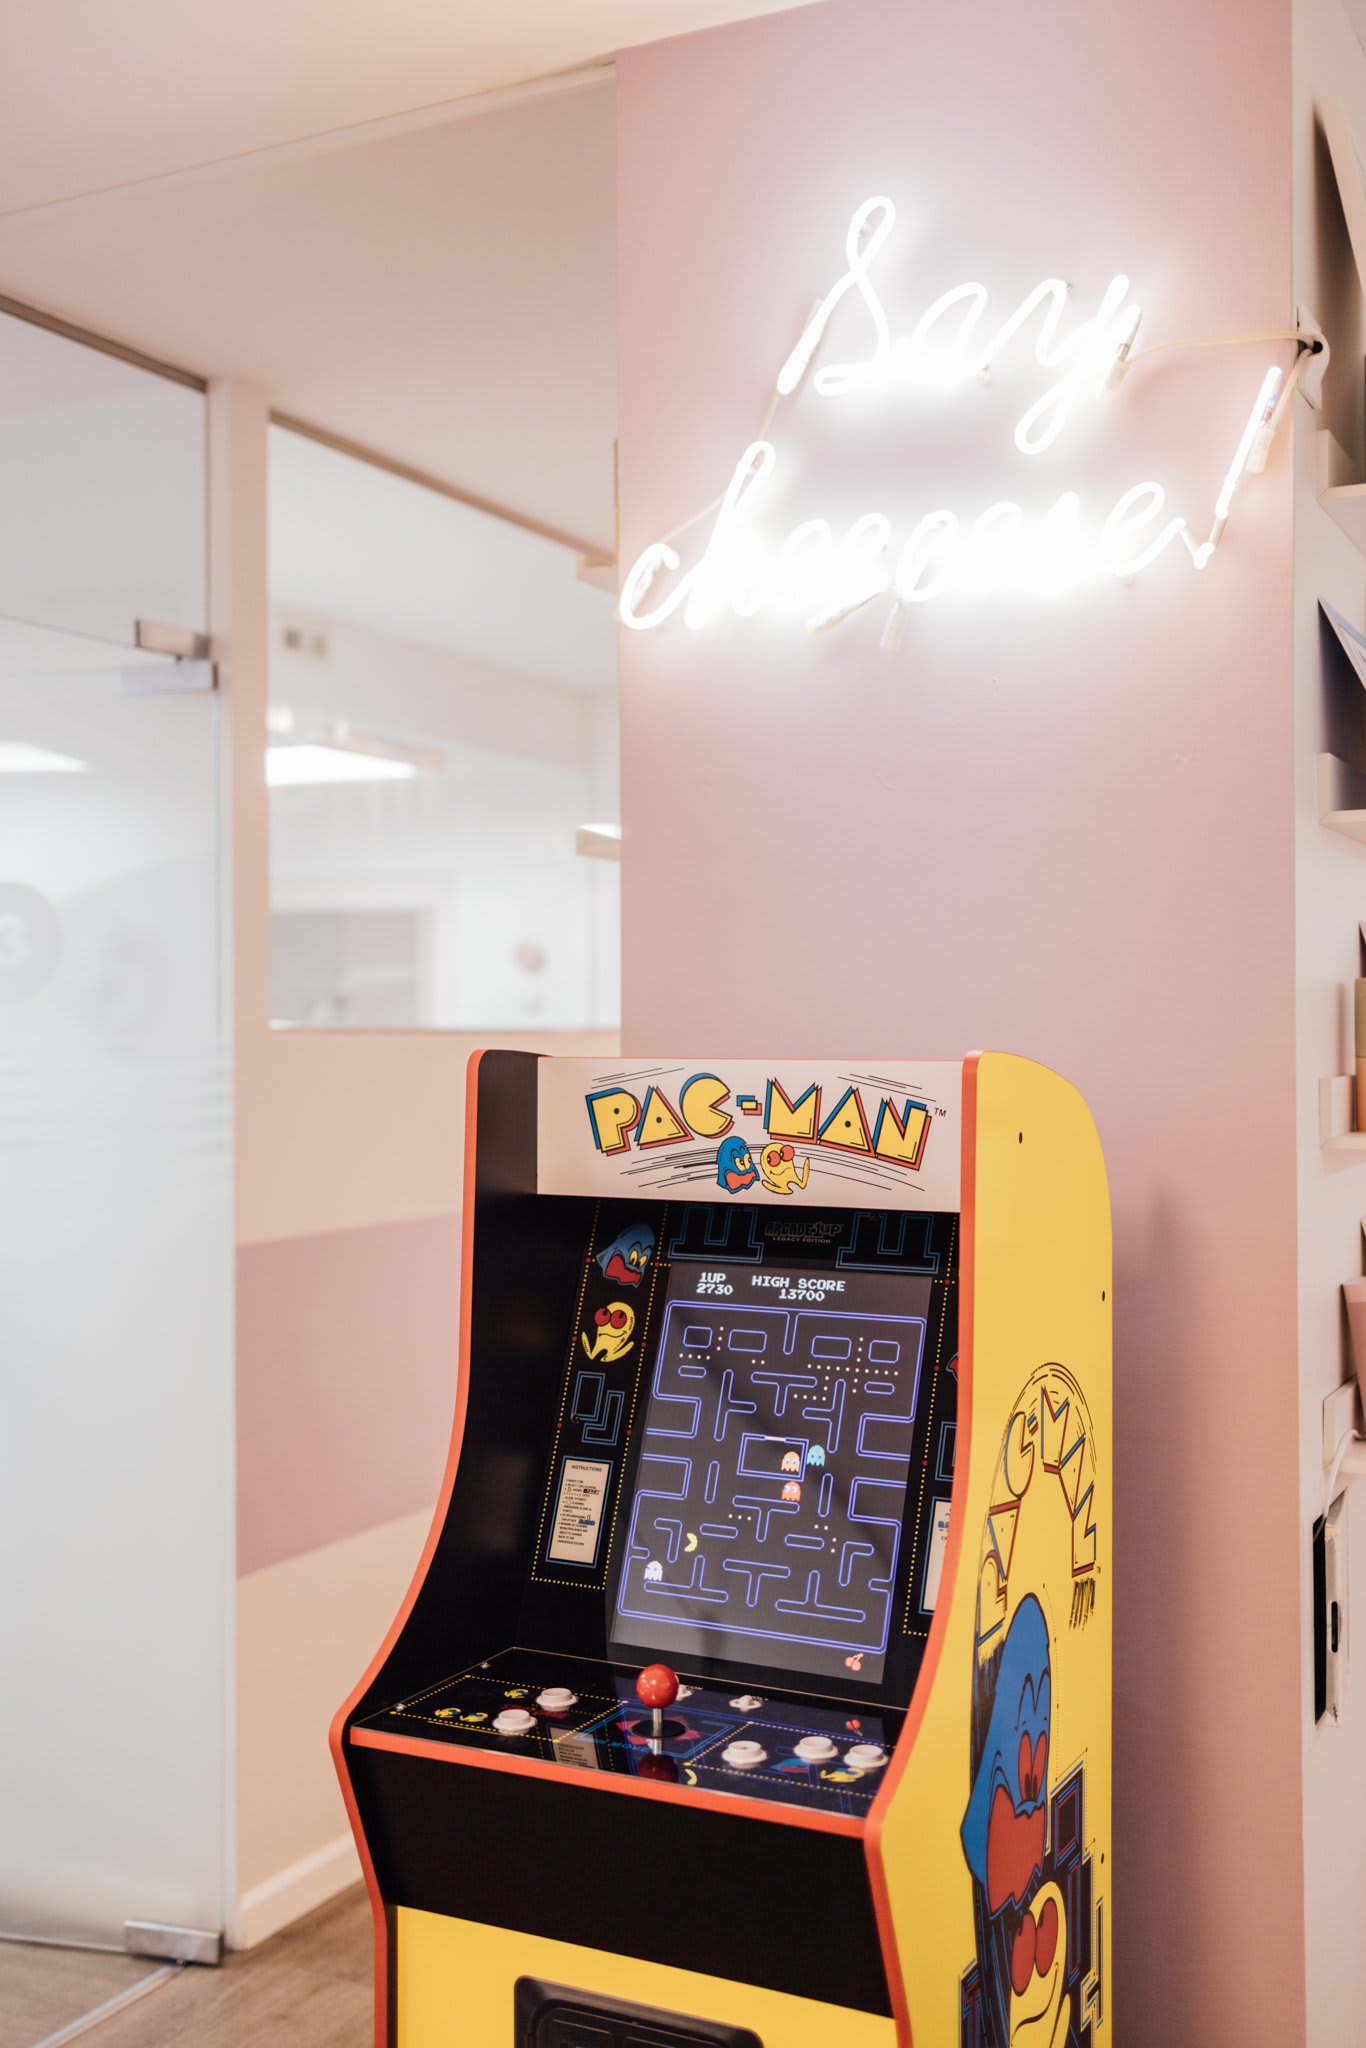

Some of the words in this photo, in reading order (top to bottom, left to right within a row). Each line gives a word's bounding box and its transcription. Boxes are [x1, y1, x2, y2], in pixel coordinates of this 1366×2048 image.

[778, 195, 1141, 454] Say
[585, 1072, 932, 1171] PAC-MAN
[699, 1272, 727, 1284] 1UP
[751, 1275, 790, 1288] HIGH
[797, 1278, 846, 1292] SCORE
[696, 1283, 733, 1295] 2730
[778, 1288, 826, 1301] 13700
[571, 1464, 603, 1473] INSTRUCTIONS
